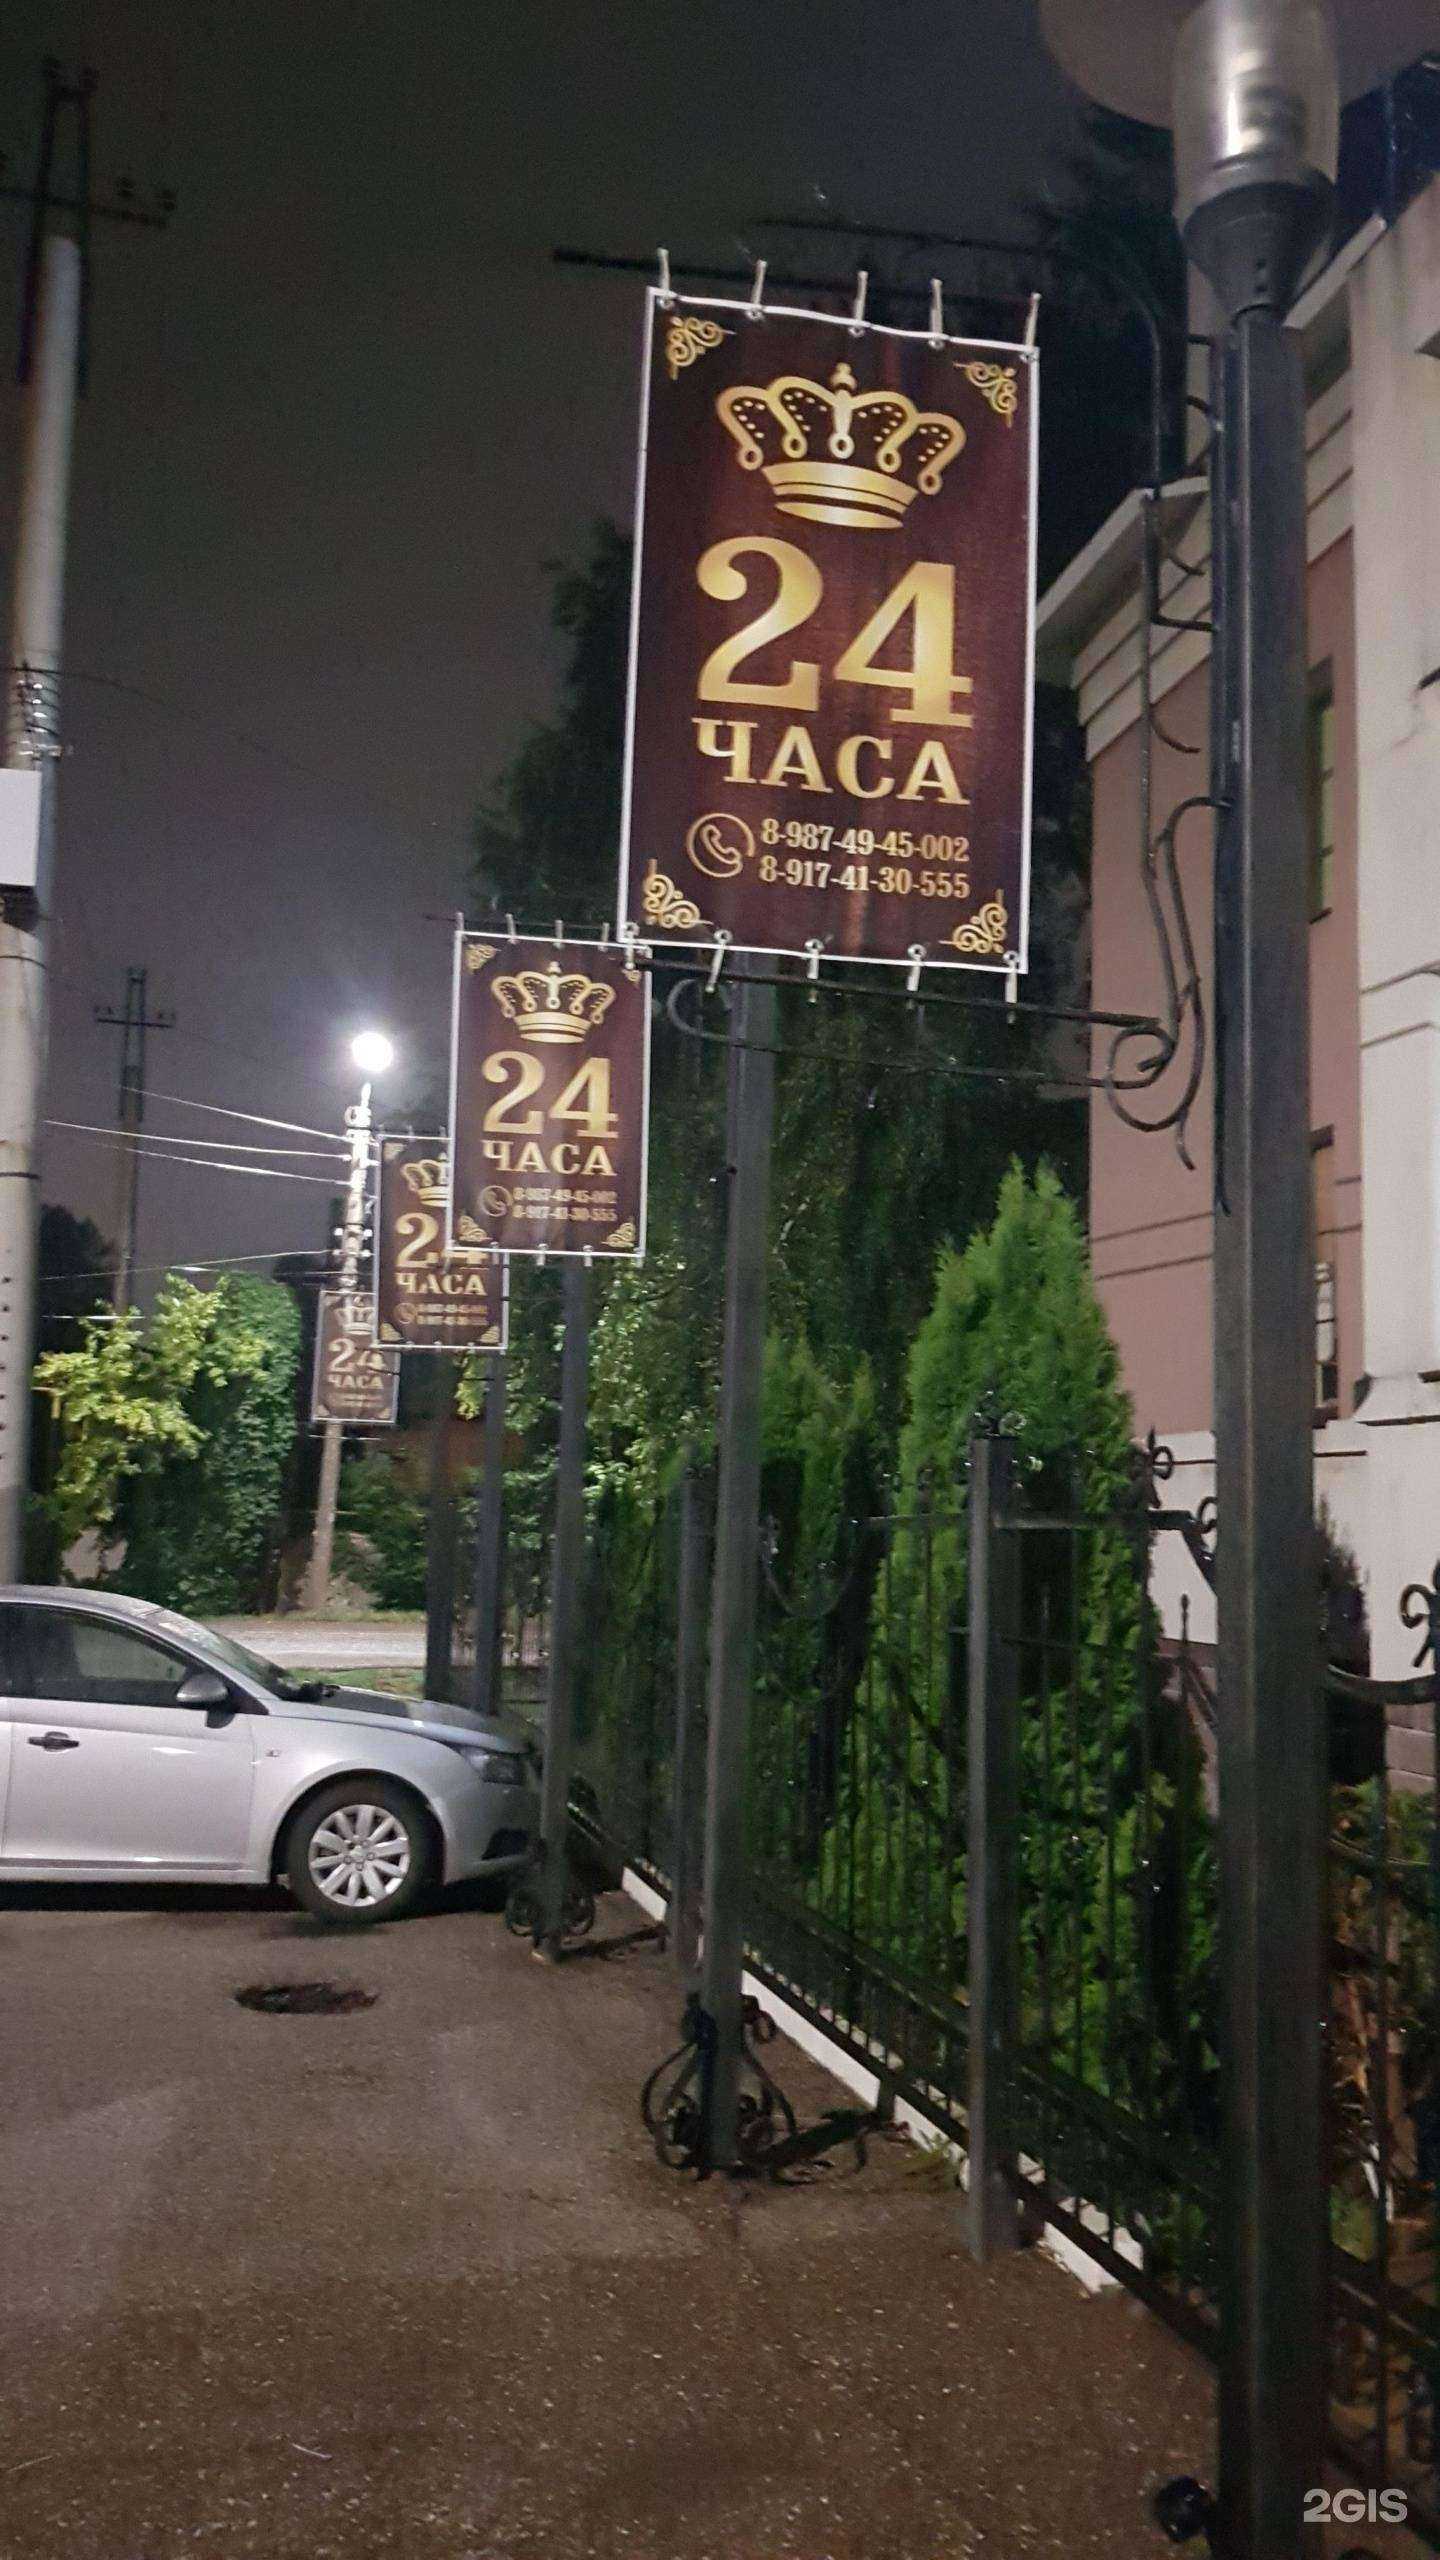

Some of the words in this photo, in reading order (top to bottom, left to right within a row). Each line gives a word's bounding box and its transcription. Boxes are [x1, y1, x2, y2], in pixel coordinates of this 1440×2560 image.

[695, 535, 974, 730] 24
[691, 716, 971, 806] ЧАСА
[760, 817, 970, 862] 8-987-49-45-002
[758, 855, 970, 899] 8-917-41-30-555
[481, 1050, 619, 1139] 24
[481, 1139, 618, 1177] ЧАСА
[394, 1272, 488, 1296] ЧАСА
